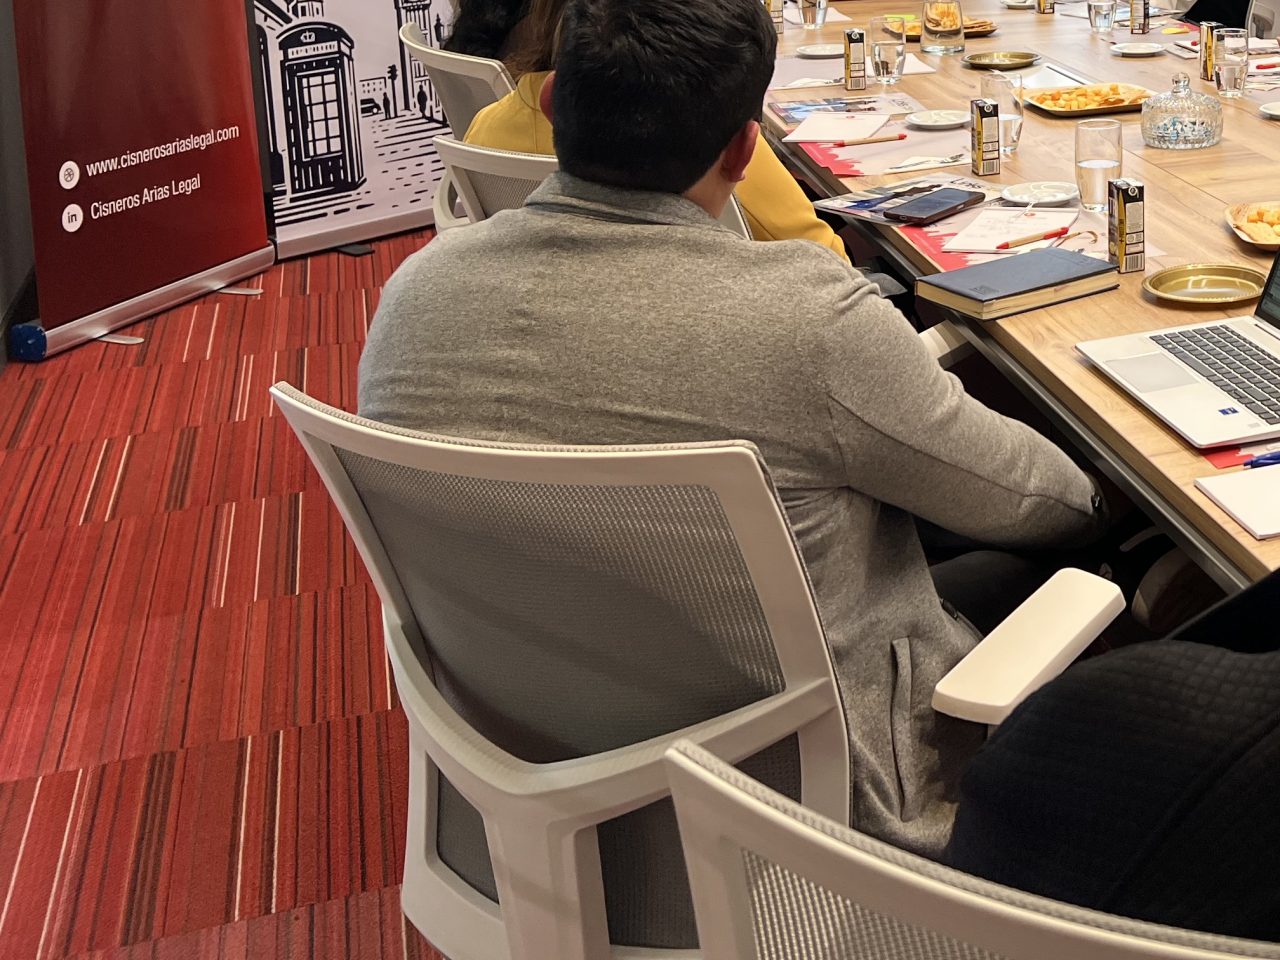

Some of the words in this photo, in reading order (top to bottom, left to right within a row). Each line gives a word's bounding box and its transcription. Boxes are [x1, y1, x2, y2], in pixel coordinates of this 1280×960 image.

[86, 125, 239, 177] www.cisnerosariaslegal.com
[90, 196, 140, 220] Cisneros
[143, 186, 170, 205] Arias
[172, 173, 201, 196] Legal
